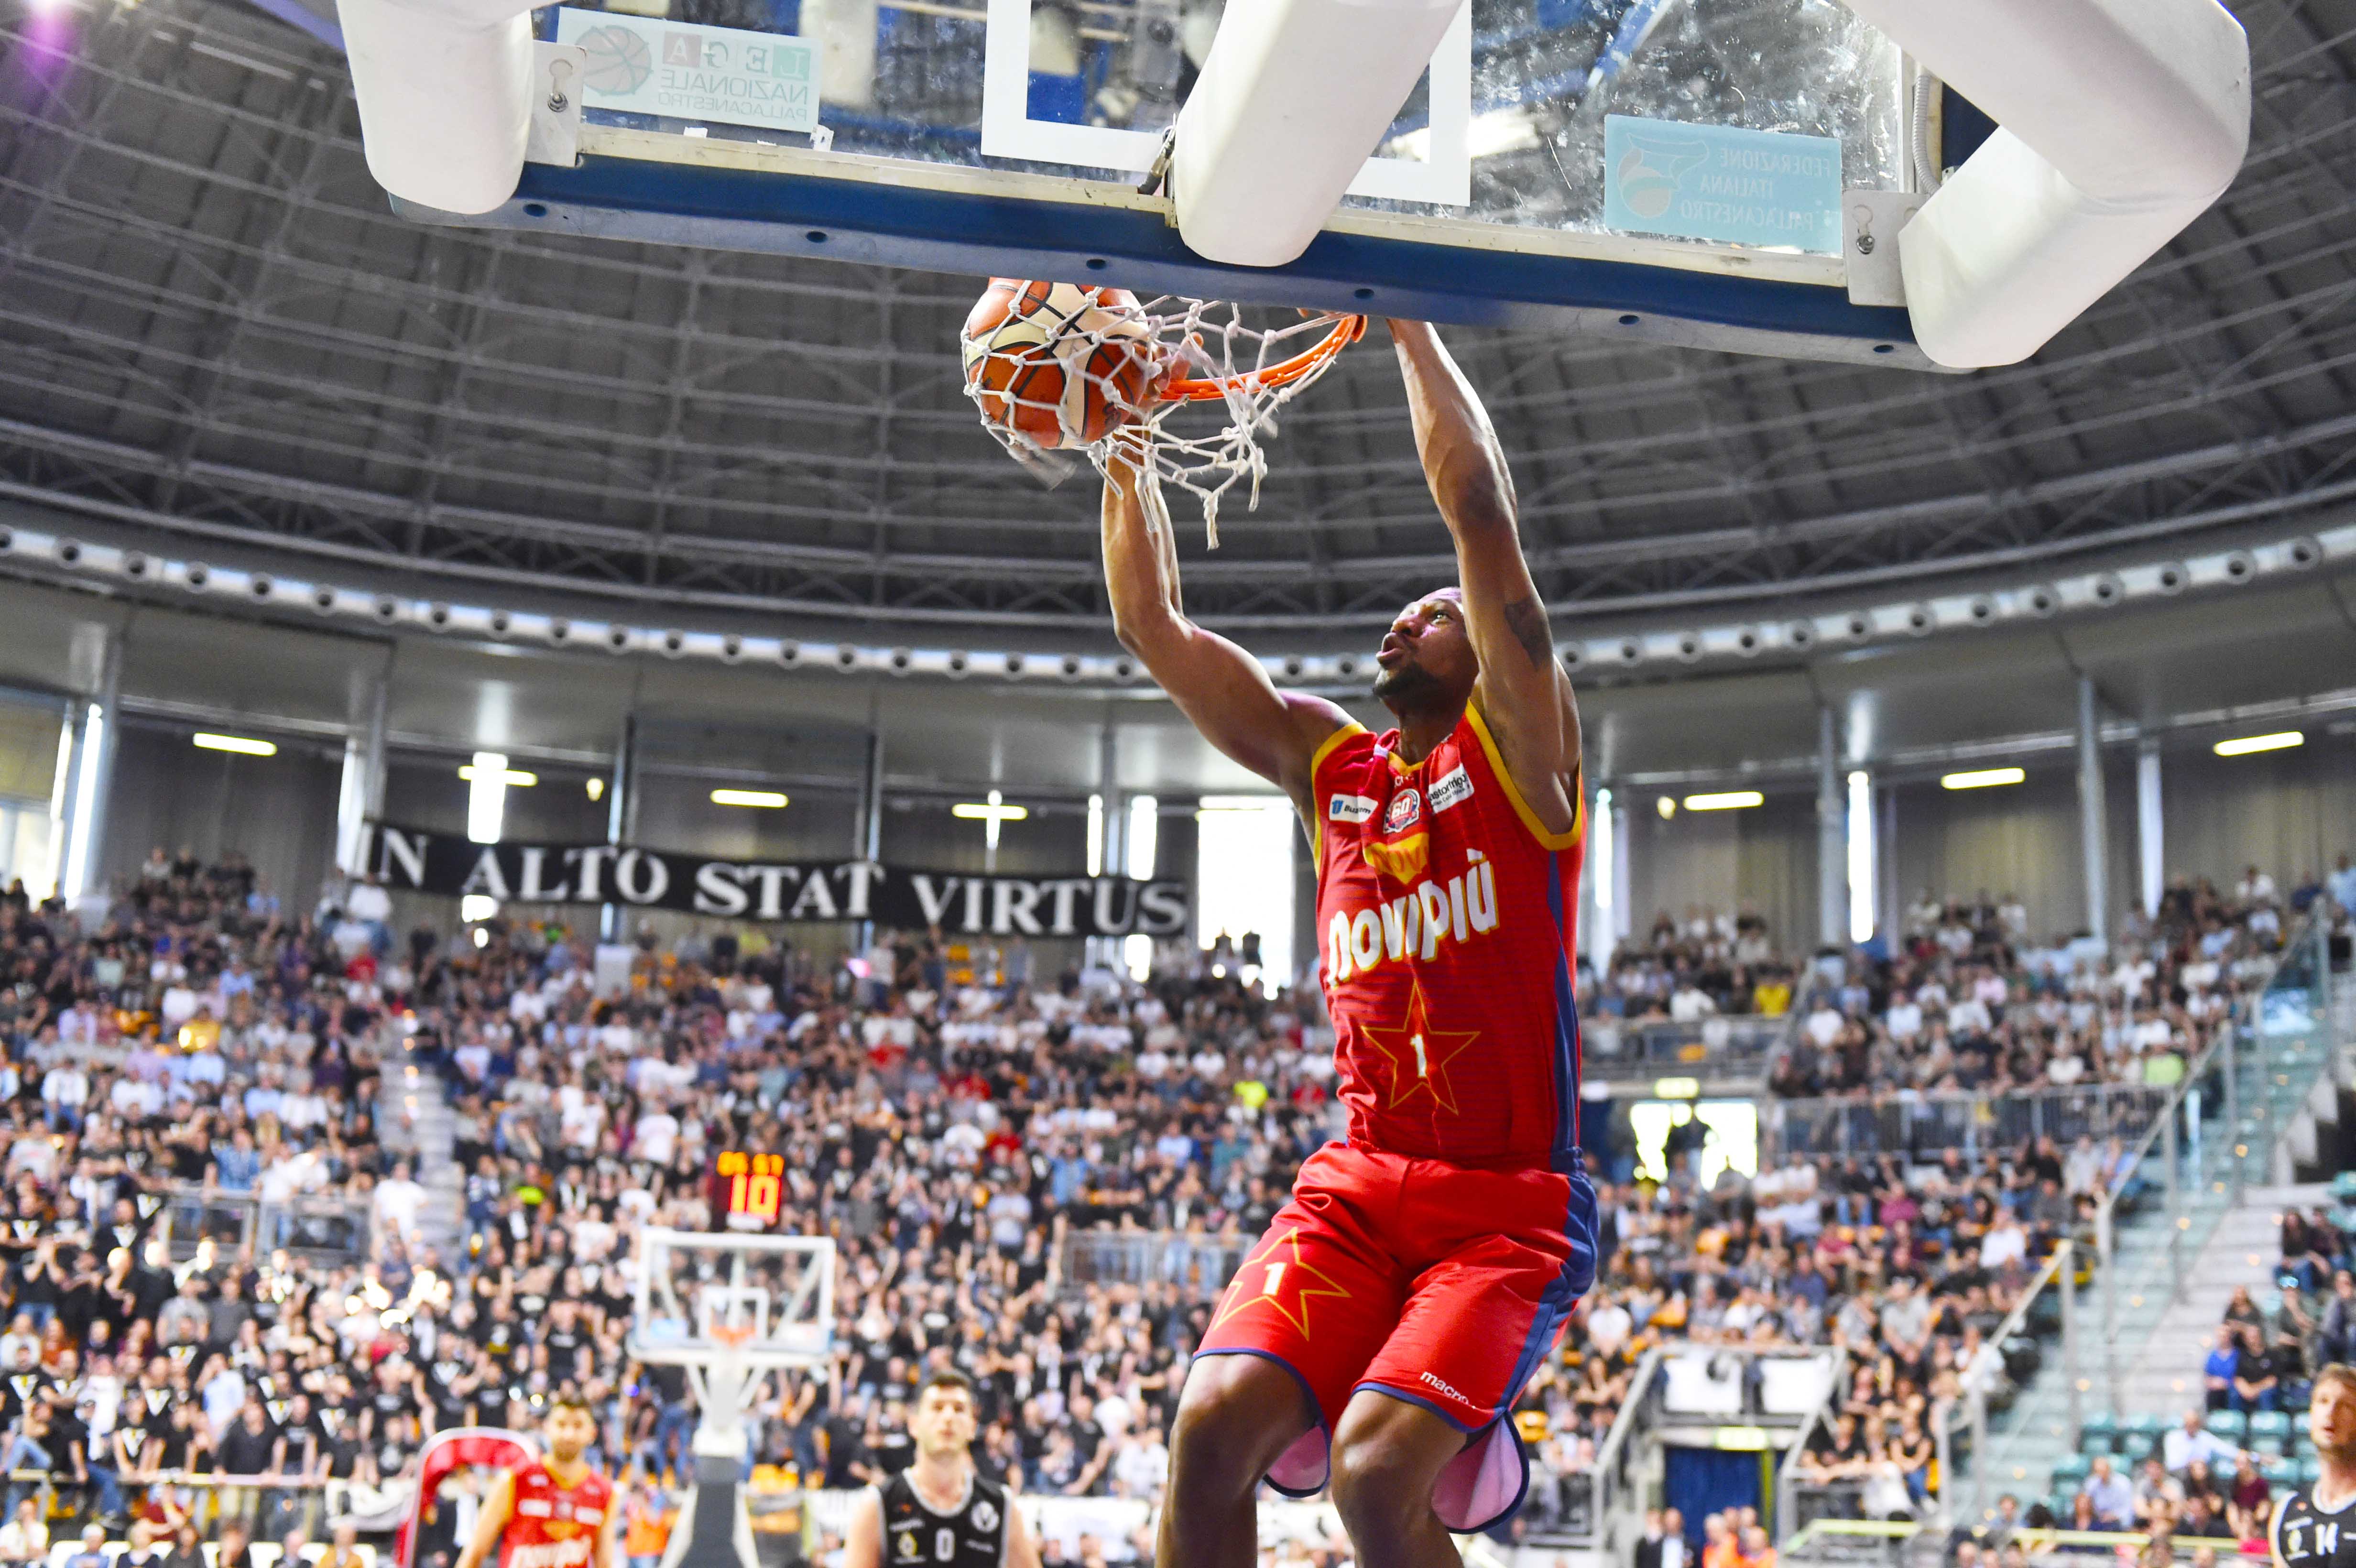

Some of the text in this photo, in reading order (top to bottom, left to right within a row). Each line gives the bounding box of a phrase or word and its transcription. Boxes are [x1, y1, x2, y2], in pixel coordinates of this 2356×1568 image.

[1391, 796, 1411, 819] 60
[354, 819, 1188, 936] IN ALTO STAT VIRTUS
[1327, 849, 1500, 988] novipiù
[1410, 1033, 1428, 1078] 1
[729, 1173, 781, 1219] 10
[1262, 1262, 1287, 1296] 1
[1419, 1371, 1476, 1409] macro
